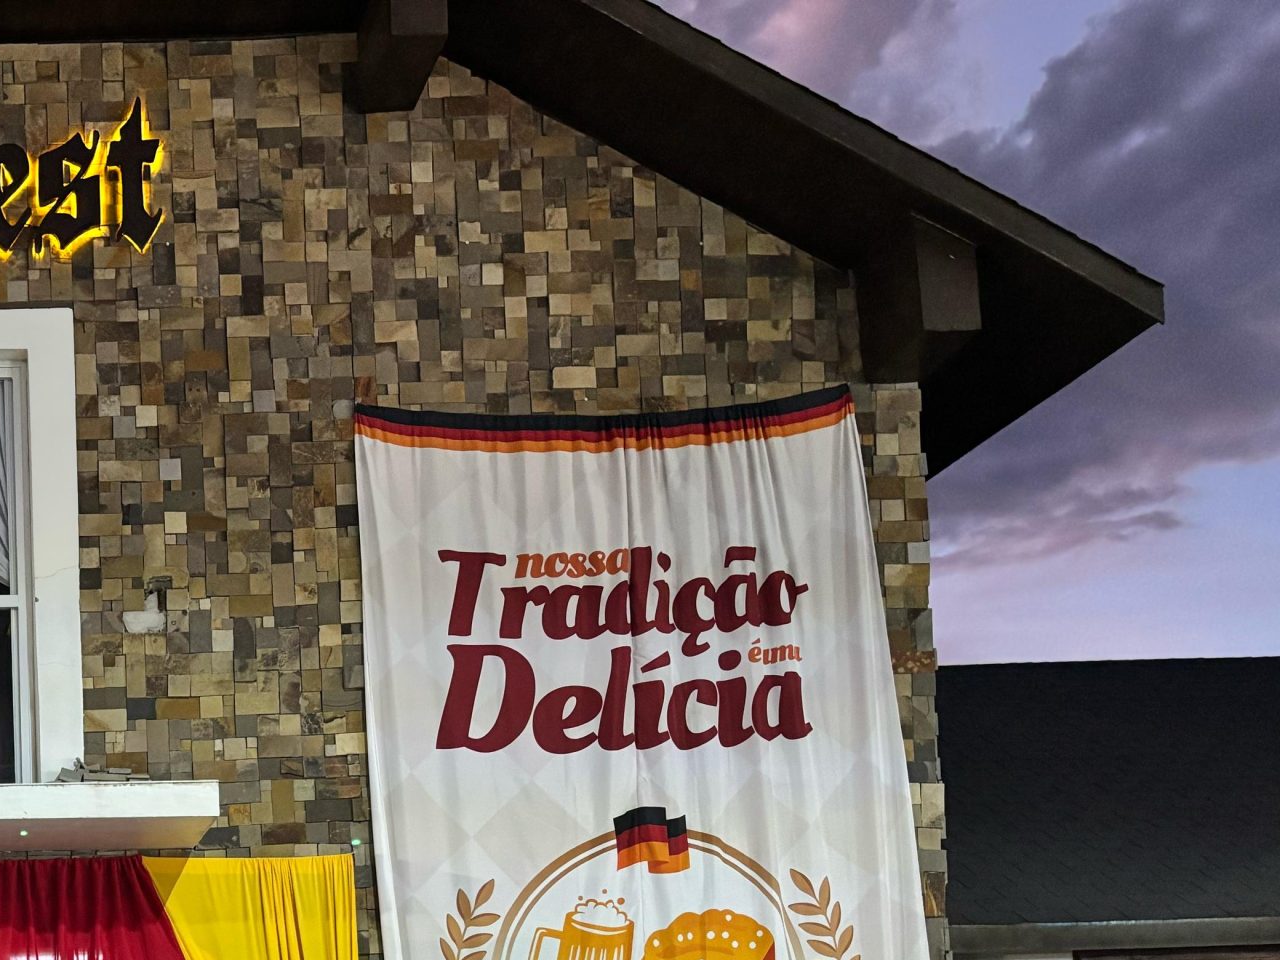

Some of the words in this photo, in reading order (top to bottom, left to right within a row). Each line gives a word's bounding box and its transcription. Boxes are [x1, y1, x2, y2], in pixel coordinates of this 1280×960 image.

[437, 545, 809, 657] Tradição
[515, 547, 630, 579] nossa
[436, 644, 813, 754] Delícia
